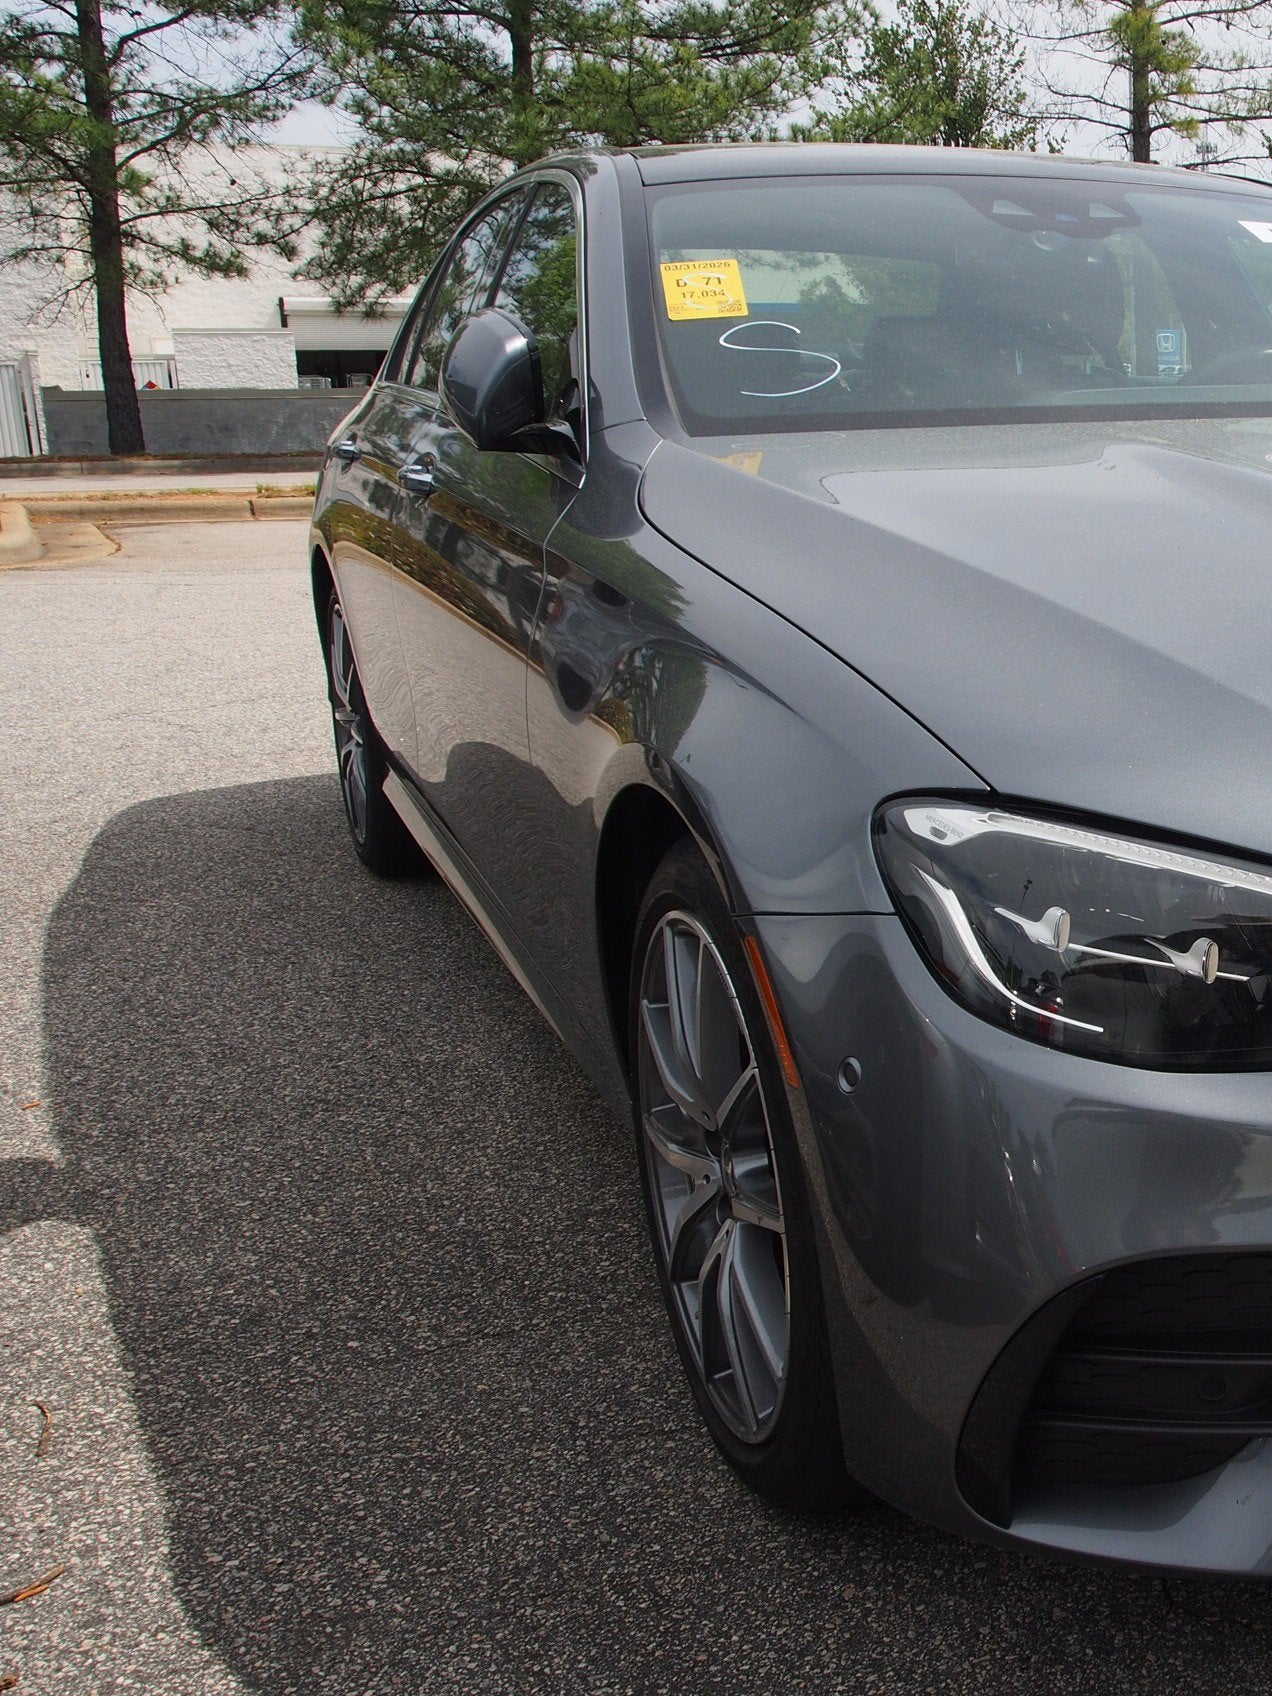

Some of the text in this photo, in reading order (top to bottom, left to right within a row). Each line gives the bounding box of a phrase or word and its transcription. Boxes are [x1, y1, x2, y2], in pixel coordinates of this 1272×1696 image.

[664, 261, 731, 271] 03/31/2026
[702, 276, 722, 286] 71
[718, 320, 842, 397] S
[925, 814, 965, 838] MERCEDES-BENZ
